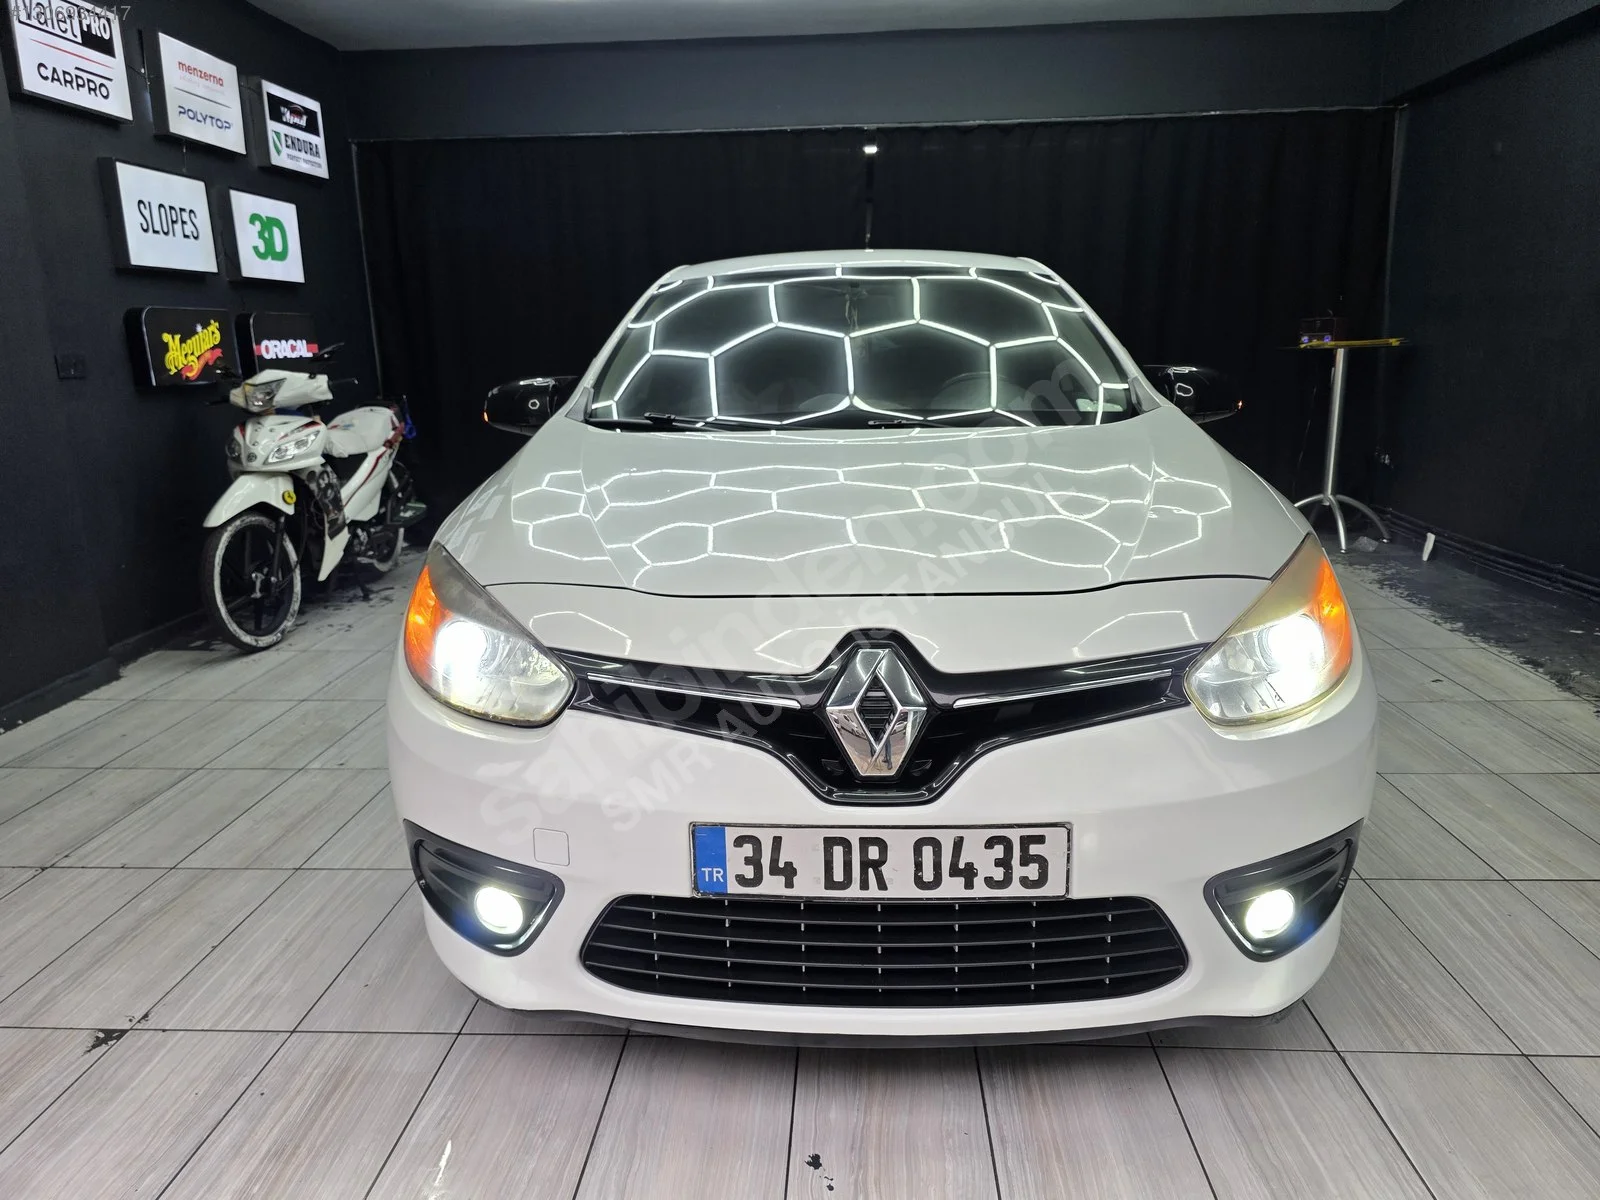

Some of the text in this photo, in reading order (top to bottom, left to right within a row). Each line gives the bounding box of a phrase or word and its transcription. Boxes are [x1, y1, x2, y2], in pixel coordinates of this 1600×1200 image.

[36, 62, 110, 100] CARPRO
[178, 61, 225, 87] menzerna
[177, 105, 232, 131] POLYTOP
[284, 133, 321, 159] ENDURA
[137, 199, 200, 241] SLOPES
[249, 212, 289, 262] 3D
[260, 339, 314, 360] ORACAL
[701, 867, 724, 882] TR
[732, 834, 1049, 891] 34 DR 0435
